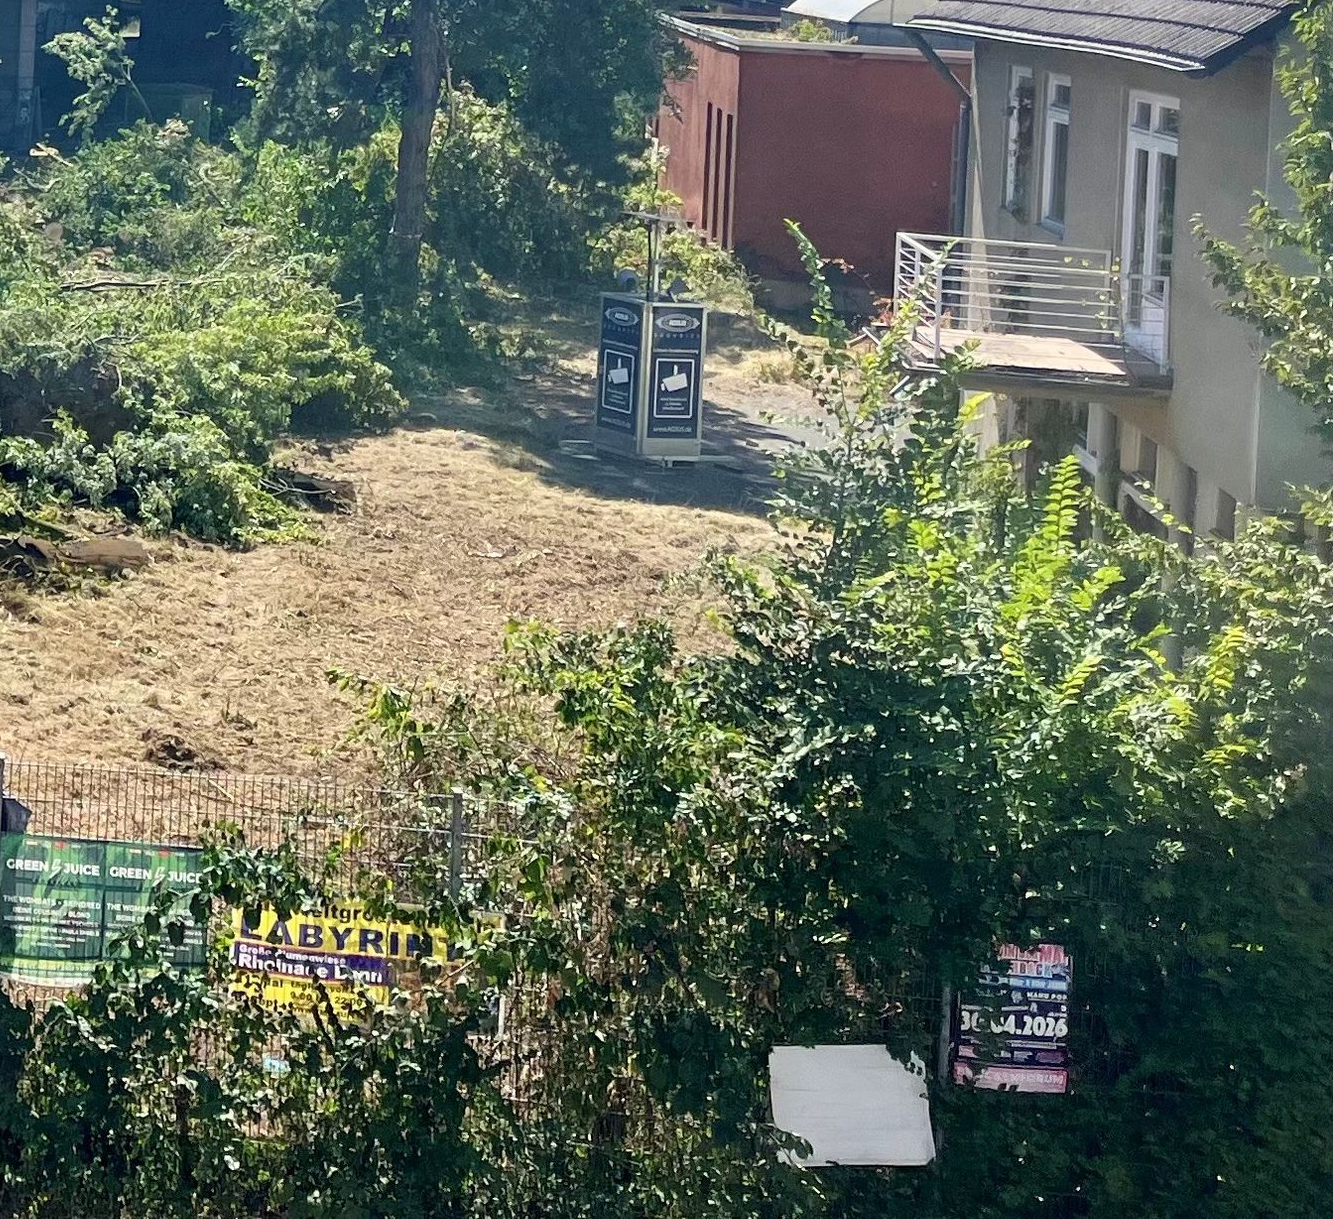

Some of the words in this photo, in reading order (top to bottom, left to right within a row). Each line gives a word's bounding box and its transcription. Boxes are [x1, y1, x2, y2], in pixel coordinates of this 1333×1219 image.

[6, 858, 49, 872] GREEN
[63, 863, 100, 876] JUICE
[109, 866, 152, 880] GREEN
